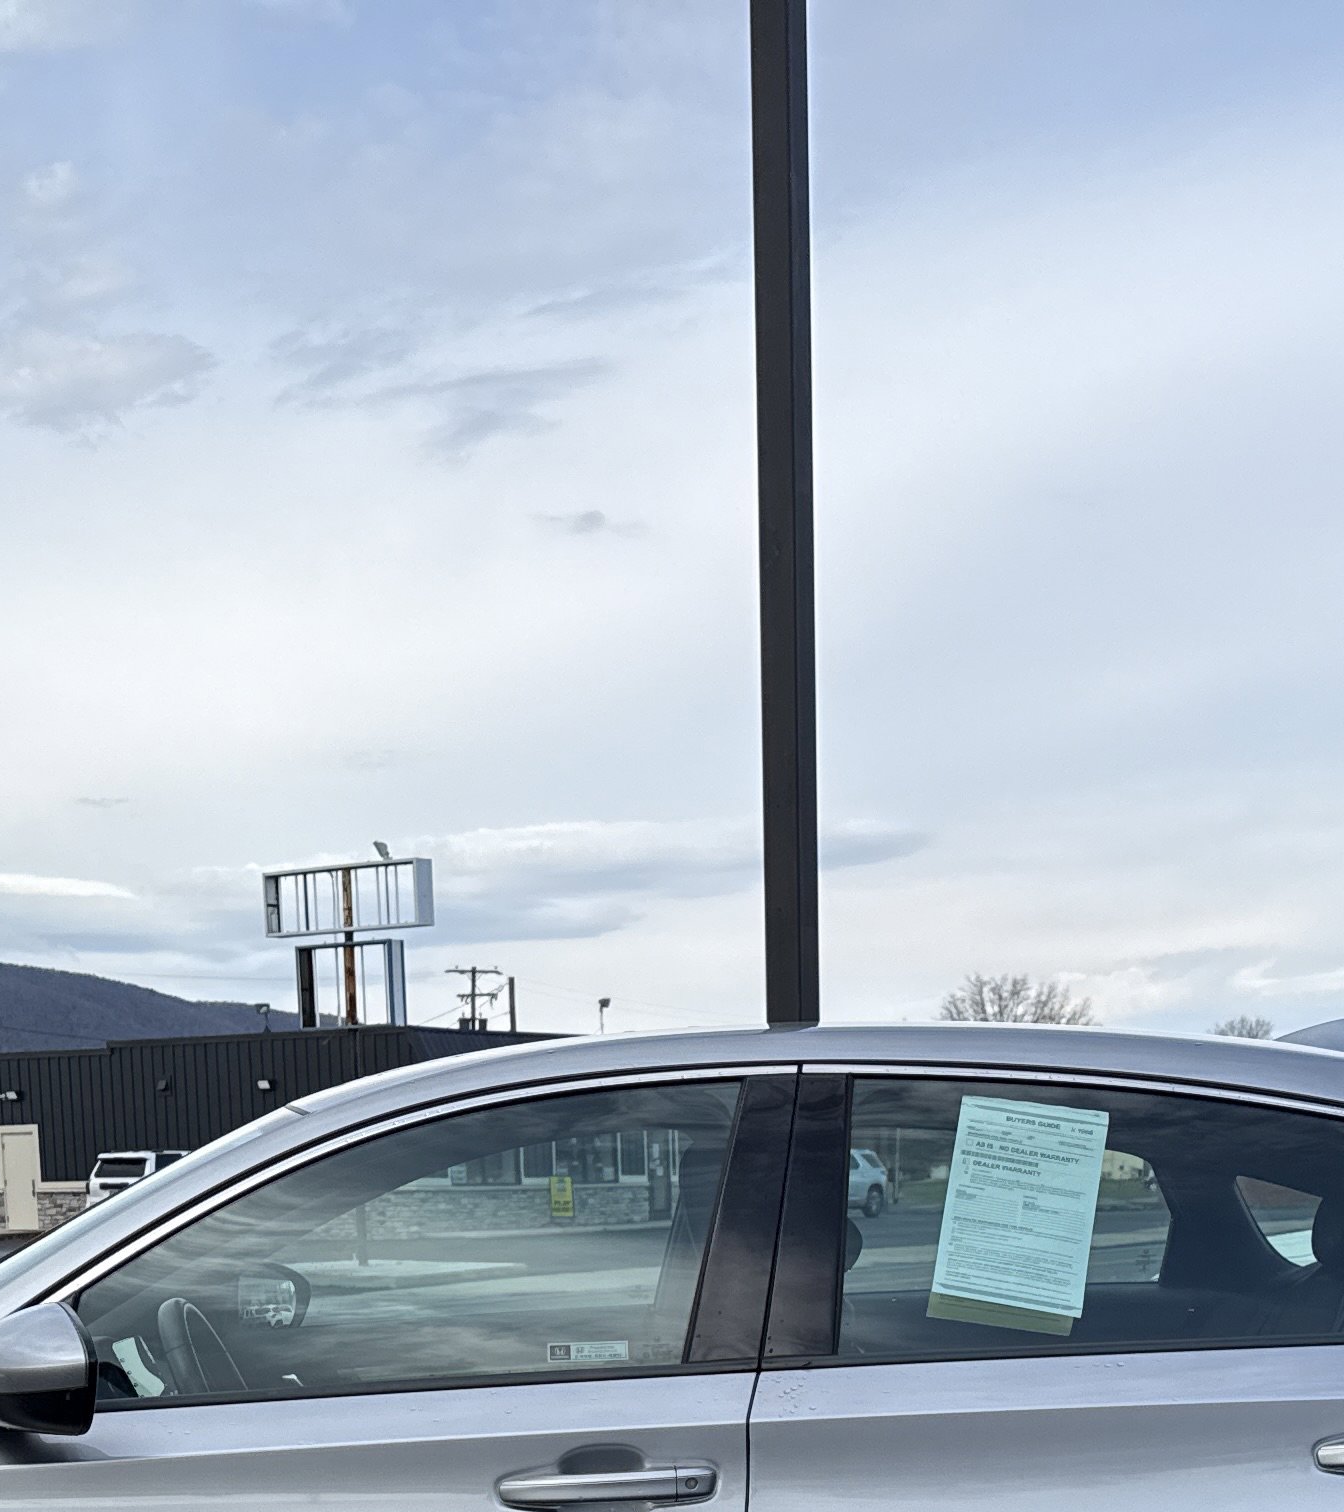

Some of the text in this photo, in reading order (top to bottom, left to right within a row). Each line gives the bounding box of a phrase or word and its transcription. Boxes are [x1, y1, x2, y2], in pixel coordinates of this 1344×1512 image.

[1006, 1116, 1061, 1130] BUYERS GUIDE
[1011, 1147, 1039, 1158] DEALER
[1040, 1151, 1080, 1164] WARRANTY
[972, 1160, 1000, 1170] DEALER
